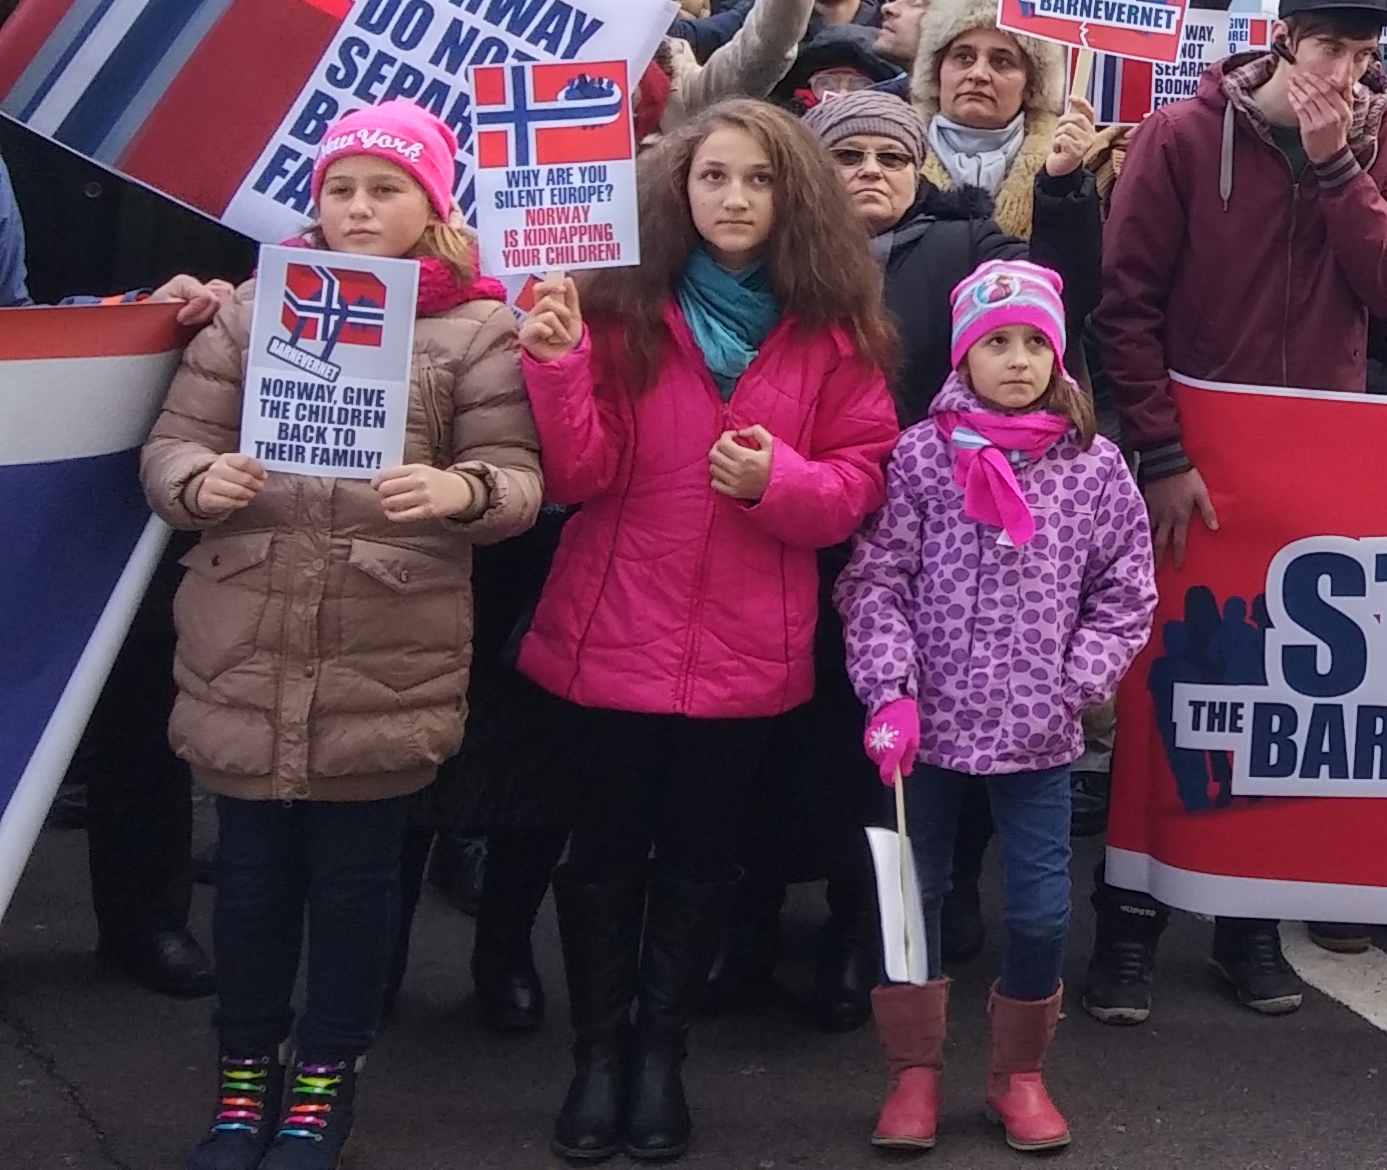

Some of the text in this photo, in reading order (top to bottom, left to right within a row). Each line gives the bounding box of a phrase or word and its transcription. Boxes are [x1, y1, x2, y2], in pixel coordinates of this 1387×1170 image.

[1183, 25, 1215, 43] WAY,
[1154, 78, 1198, 95] BODNA
[357, 128, 424, 163] York
[505, 165, 607, 188] WHY ARE YOU
[494, 184, 614, 209] SILENT EUROPE?
[525, 205, 590, 227] NORWAY
[504, 223, 613, 248] IS KIDNAPPING
[502, 242, 621, 268] YOUR CHILDREN!
[269, 338, 340, 380] BARNEVERNET
[260, 377, 386, 408] NORWAY, GIVE
[259, 398, 386, 428] THE CHILDREN
[277, 422, 356, 447] BACK TO
[254, 441, 382, 470] THEIR FAMILY!
[1188, 700, 1244, 733] THE
